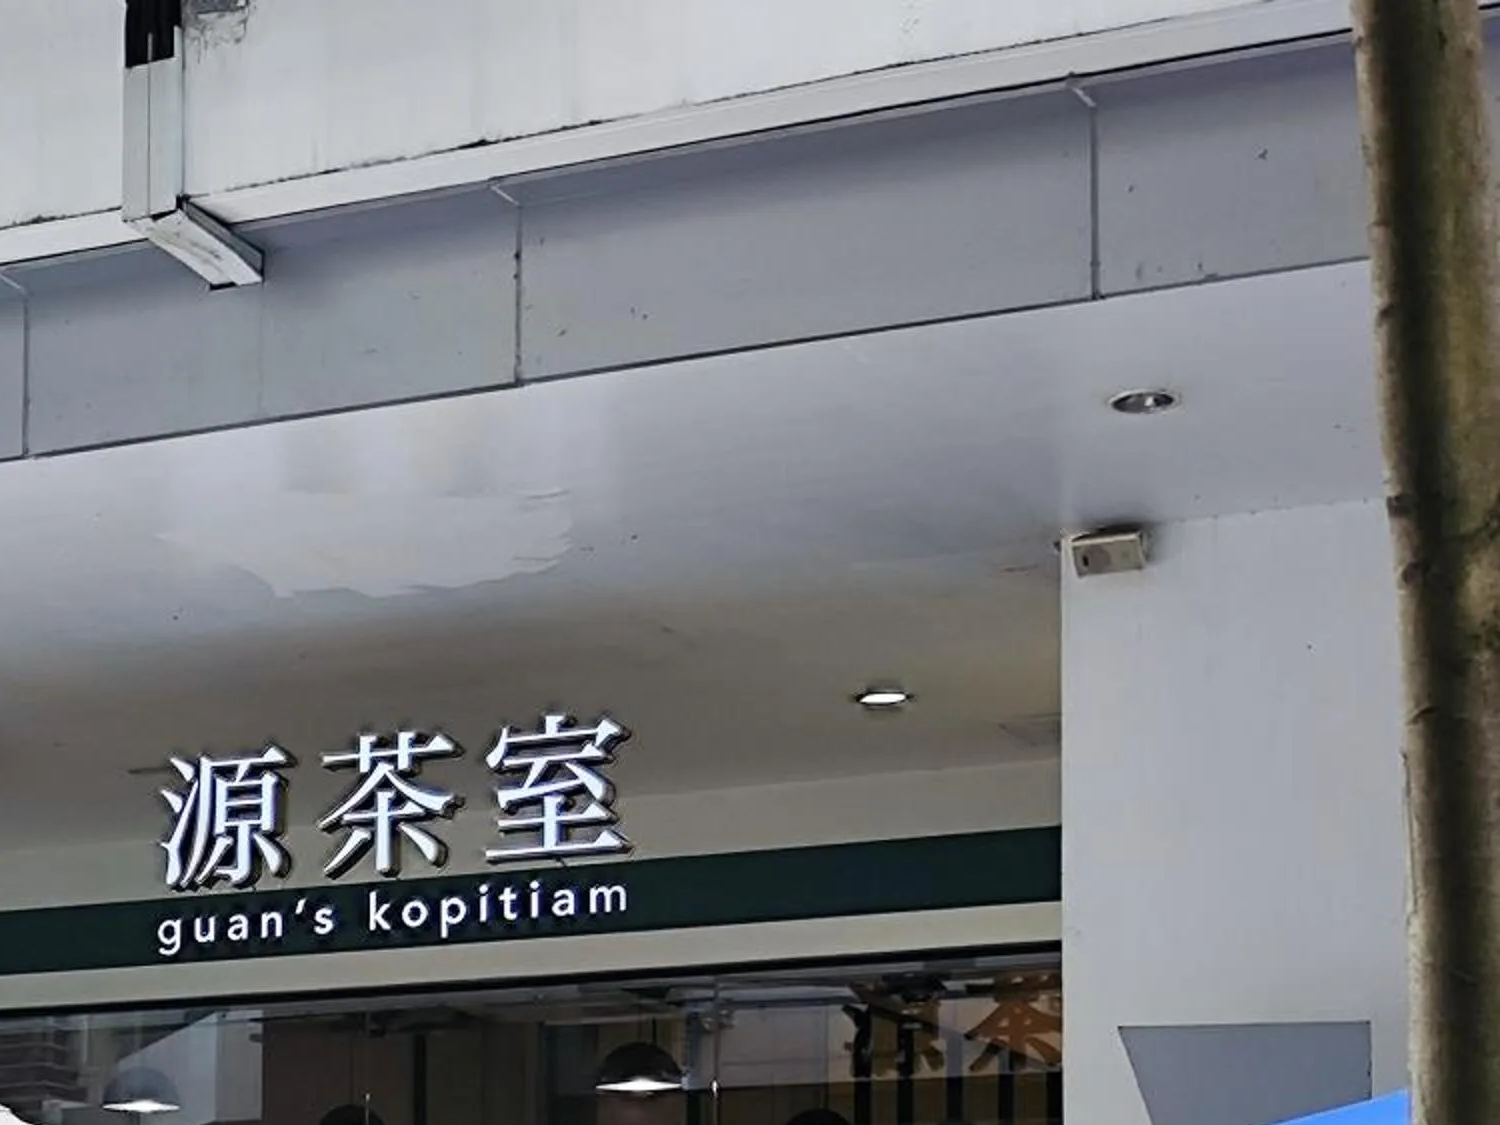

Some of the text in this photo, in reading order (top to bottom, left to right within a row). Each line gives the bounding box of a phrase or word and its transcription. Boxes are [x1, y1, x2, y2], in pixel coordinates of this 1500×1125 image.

[158, 713, 632, 889] 源茶室
[157, 880, 627, 956] guan's kopitiam
